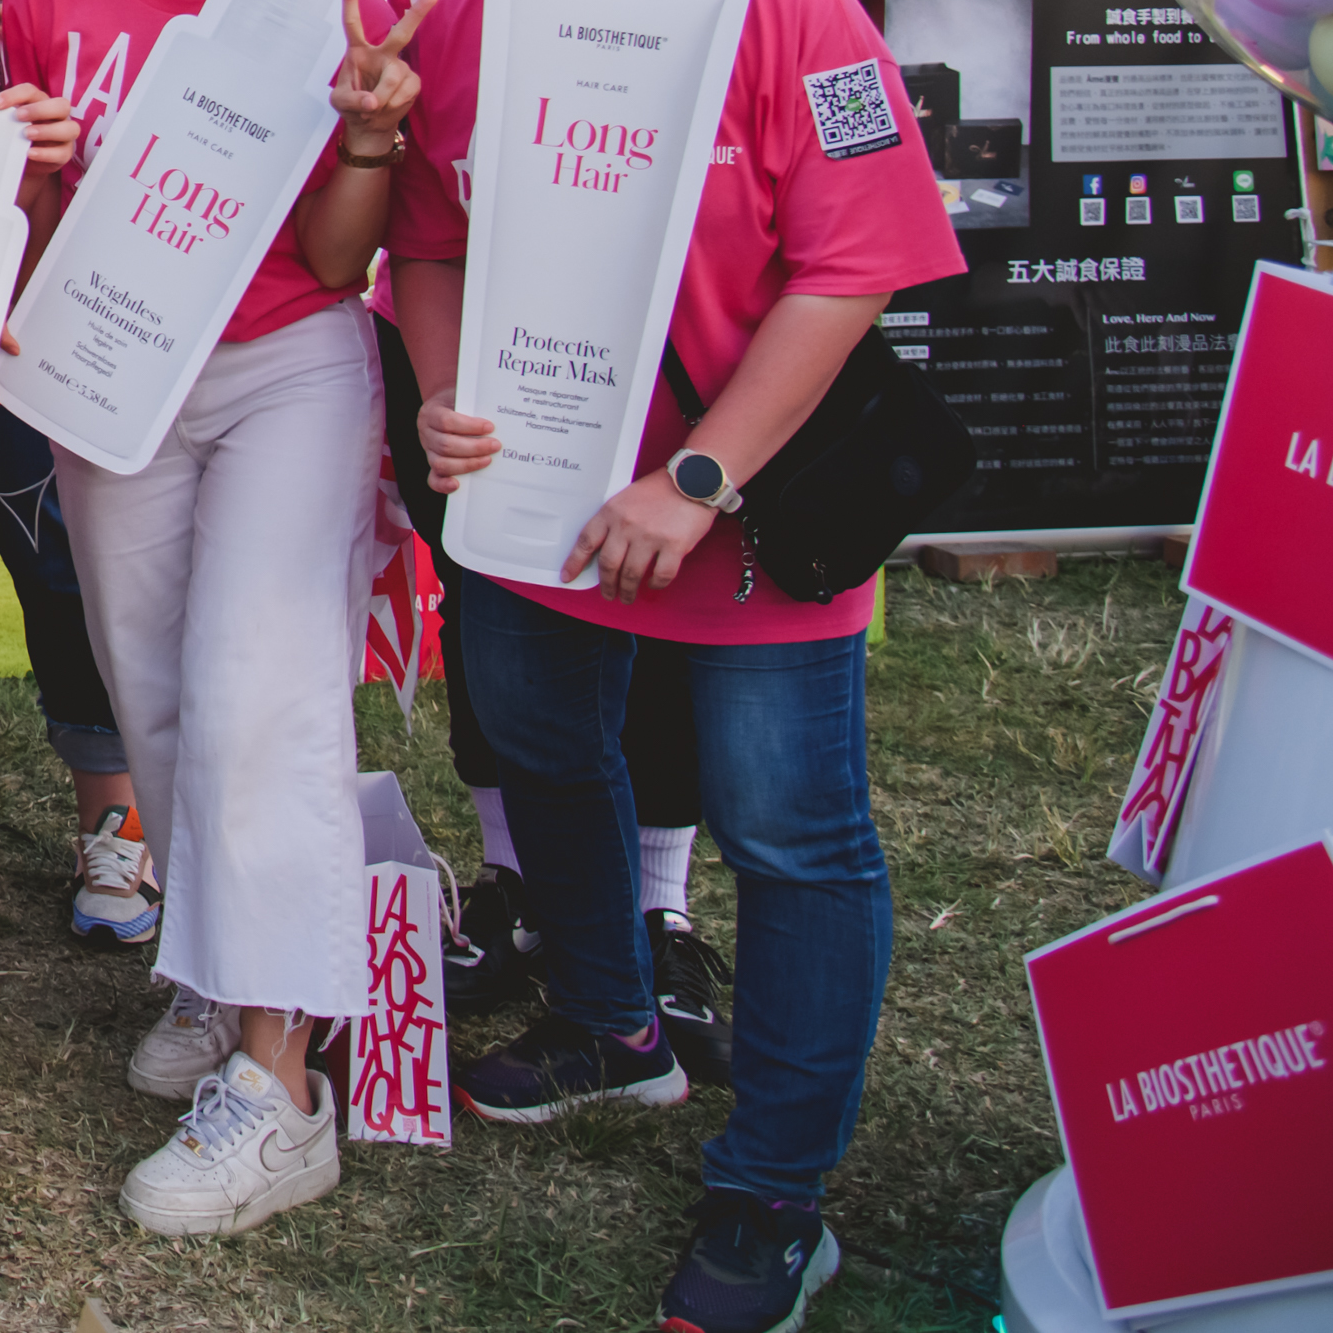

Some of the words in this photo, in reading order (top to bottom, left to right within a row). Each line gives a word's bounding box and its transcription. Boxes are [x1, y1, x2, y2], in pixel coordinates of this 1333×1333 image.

[559, 24, 573, 39] LA
[1066, 31, 1099, 45] From
[1106, 30, 1145, 45] whole
[1153, 30, 1183, 45] food
[1188, 31, 1202, 45] to
[597, 44, 621, 52] PARIS
[62, 31, 130, 121] LA
[576, 80, 599, 90] HAIR
[603, 83, 629, 94] CARE
[183, 86, 195, 104] LA
[208, 116, 233, 134] PARIS
[533, 96, 658, 170] Long
[187, 129, 210, 148] HAIR
[210, 143, 235, 161] CARE
[129, 133, 245, 240] Long
[551, 152, 628, 194] Hair
[129, 192, 204, 256] Hair
[1007, 257, 1146, 283] 五大誠食保證
[89, 270, 164, 326] Weightless
[63, 278, 153, 345] Conditioning
[153, 332, 175, 353] Oil
[1102, 314, 1134, 324] Love,
[1136, 314, 1163, 323] Here
[1166, 313, 1188, 323] And
[1190, 313, 1216, 322] Now
[87, 320, 104, 334] Huile
[104, 331, 115, 340] de
[114, 336, 128, 349] soin
[511, 326, 611, 361] Protective
[38, 359, 56, 376] 100
[53, 371, 68, 385] ml
[497, 349, 562, 378] Repair
[565, 360, 618, 388] Mask
[517, 384, 548, 398] Masque
[549, 389, 589, 403] réparateur
[532, 398, 579, 411] restructurant
[525, 420, 569, 435] Haarmaske
[541, 413, 602, 430] restrukturierende
[502, 449, 517, 461] 150
[518, 452, 530, 462] ml
[545, 455, 561, 467] 5.0
[1285, 432, 1320, 479] LA
[367, 874, 408, 934] LA
[1105, 1077, 1139, 1123] LA
[1189, 1093, 1243, 1121] PARIS
